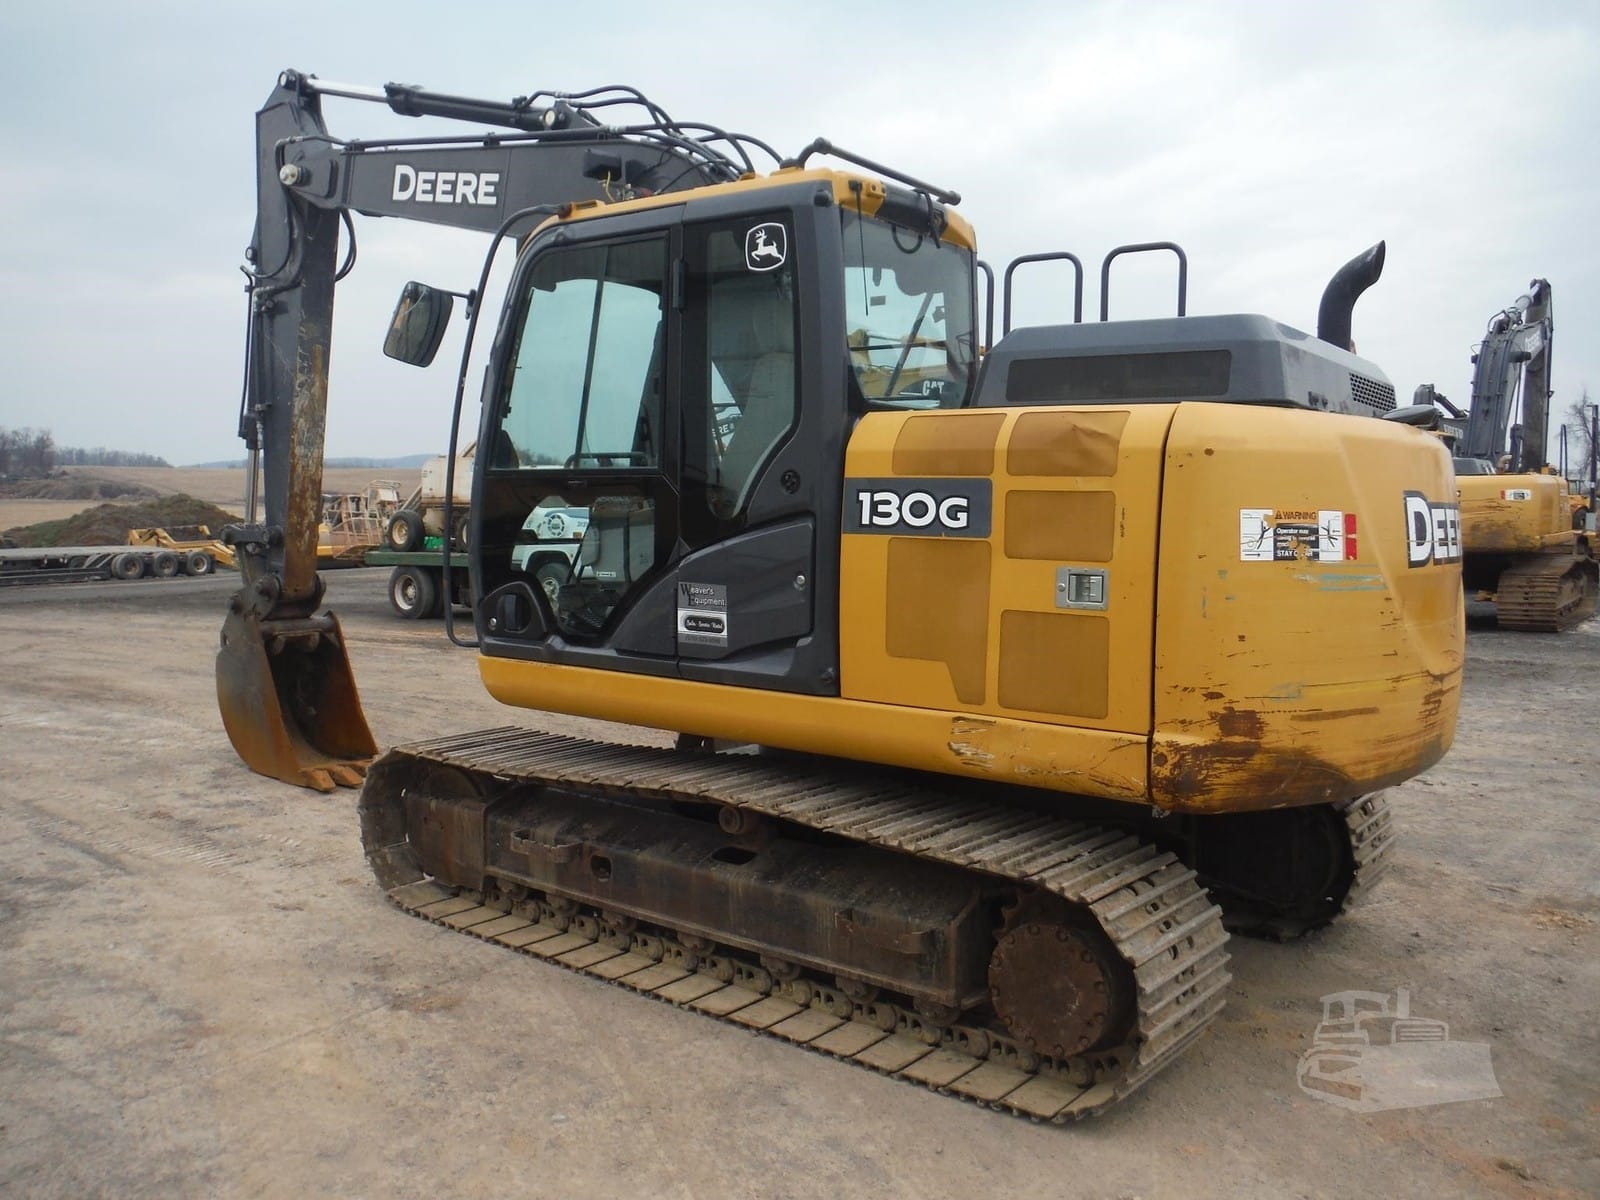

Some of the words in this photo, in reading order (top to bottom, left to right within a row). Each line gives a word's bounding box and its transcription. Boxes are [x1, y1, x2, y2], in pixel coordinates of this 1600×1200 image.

[391, 164, 500, 205] DEERE
[858, 491, 969, 529] 130G
[1283, 511, 1316, 519] WARNING
[1405, 496, 1461, 562] DEE
[688, 595, 725, 606] Equipment
